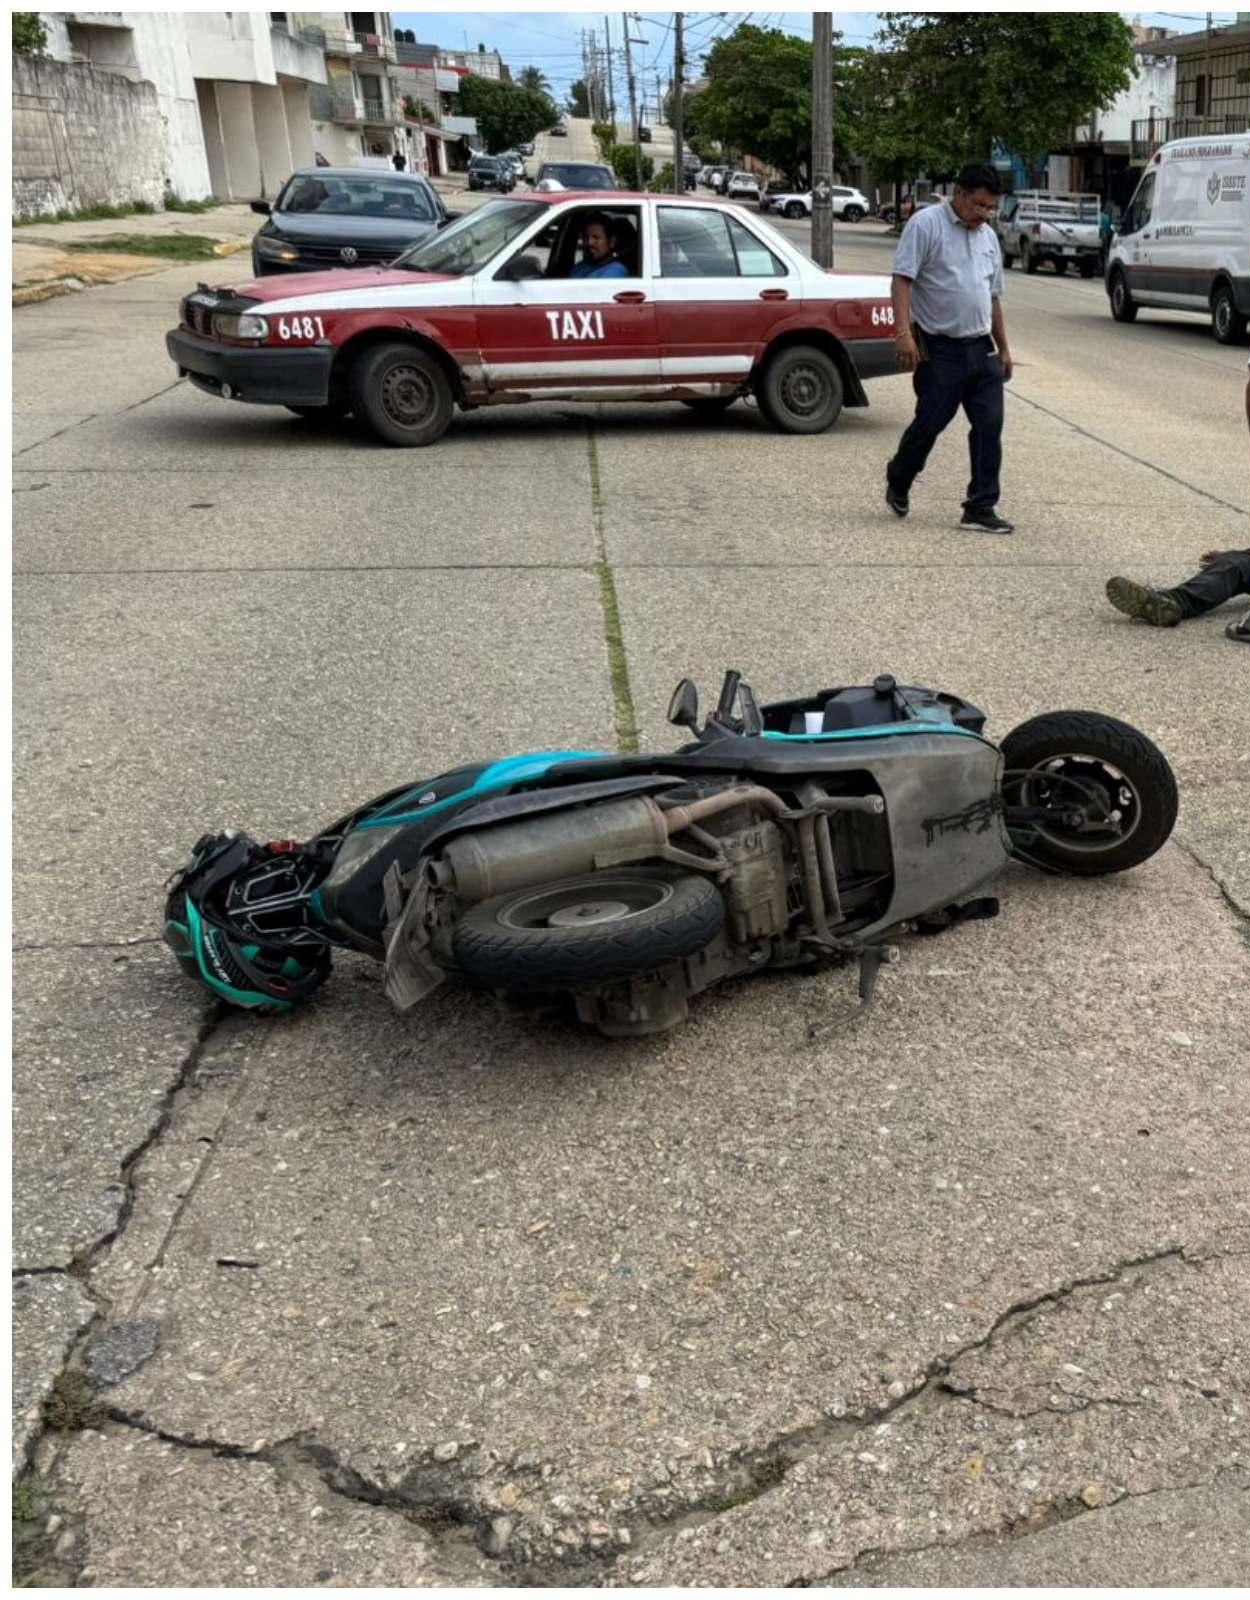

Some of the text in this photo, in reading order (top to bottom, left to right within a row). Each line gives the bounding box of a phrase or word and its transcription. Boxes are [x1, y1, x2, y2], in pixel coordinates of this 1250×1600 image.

[278, 316, 325, 340] 6481
[546, 310, 605, 340] TAXI
[872, 306, 895, 326] 648
